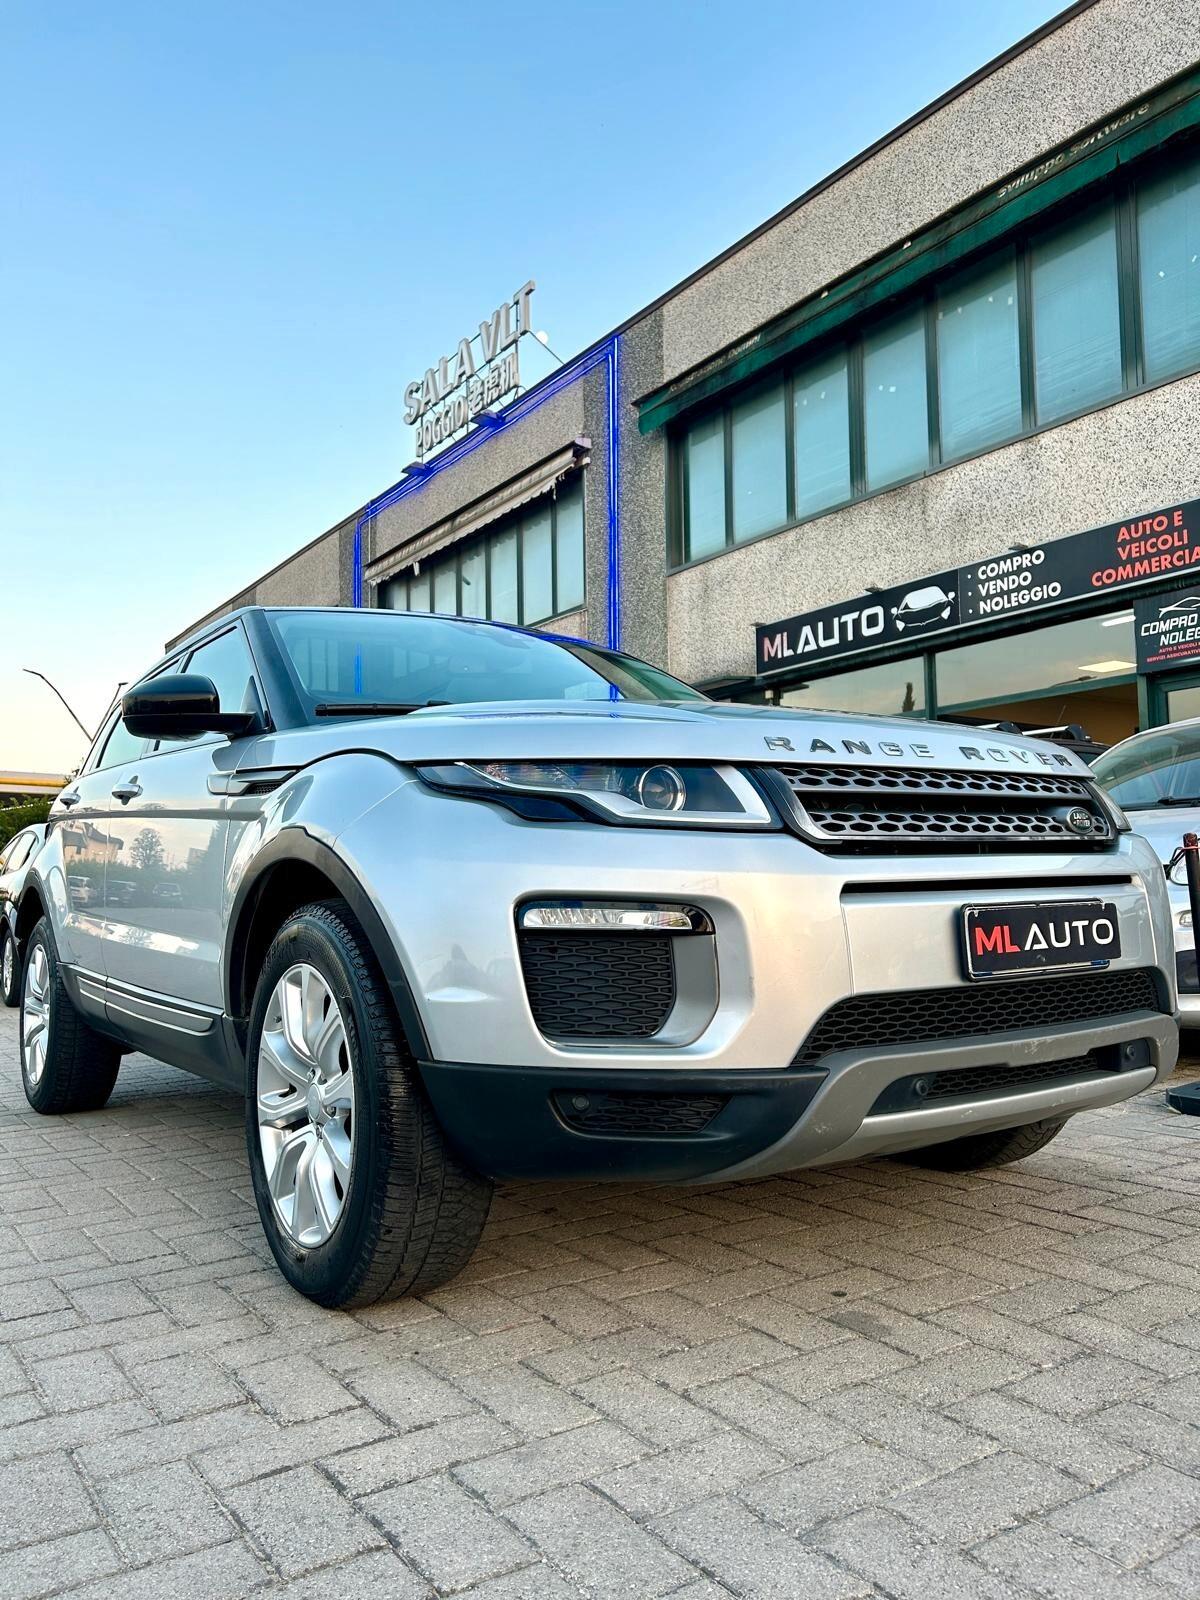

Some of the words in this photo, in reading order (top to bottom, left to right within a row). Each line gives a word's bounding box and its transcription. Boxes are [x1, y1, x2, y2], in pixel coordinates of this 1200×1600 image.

[403, 337, 475, 425] SALA
[479, 280, 536, 363] VLT
[415, 395, 469, 457] POGGIO
[1116, 515, 1169, 543] AUTO
[1173, 510, 1183, 527] E
[1117, 529, 1188, 560] VEICOLI
[977, 549, 1045, 580] COMPRO
[1091, 546, 1200, 587] COMMERCIA
[978, 571, 1032, 597] VENDO
[979, 581, 1062, 615] NOLEGGIO
[1140, 613, 1198, 636] COMPRO
[764, 736, 935, 758] RANGE
[959, 746, 1073, 767] ROVER
